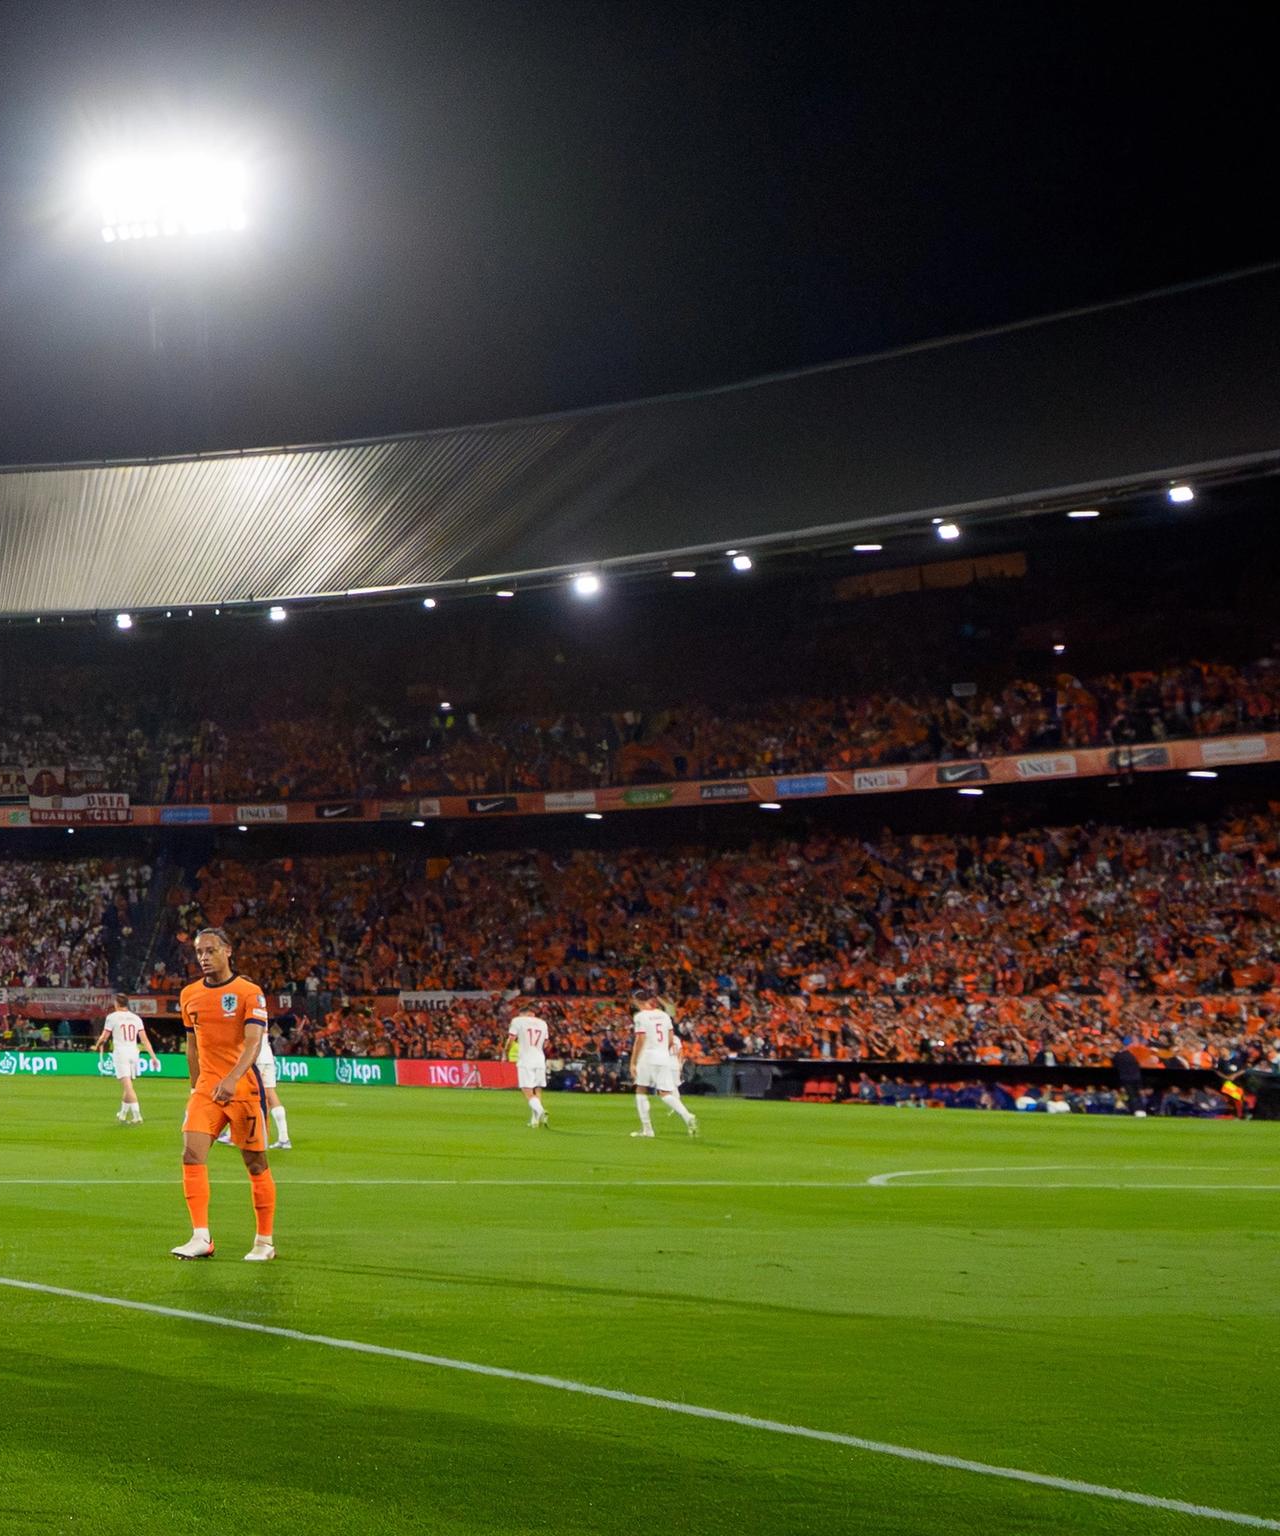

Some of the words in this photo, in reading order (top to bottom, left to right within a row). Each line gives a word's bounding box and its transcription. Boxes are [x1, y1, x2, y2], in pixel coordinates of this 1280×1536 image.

[120, 1023, 136, 1042] 10
[527, 1028, 542, 1047] 17
[655, 1023, 664, 1042] 5
[19, 1053, 57, 1075] kpn
[282, 1058, 308, 1079] kpn
[353, 1059, 381, 1080] kpn
[429, 1066, 459, 1084] ING
[246, 1115, 257, 1138] 7
